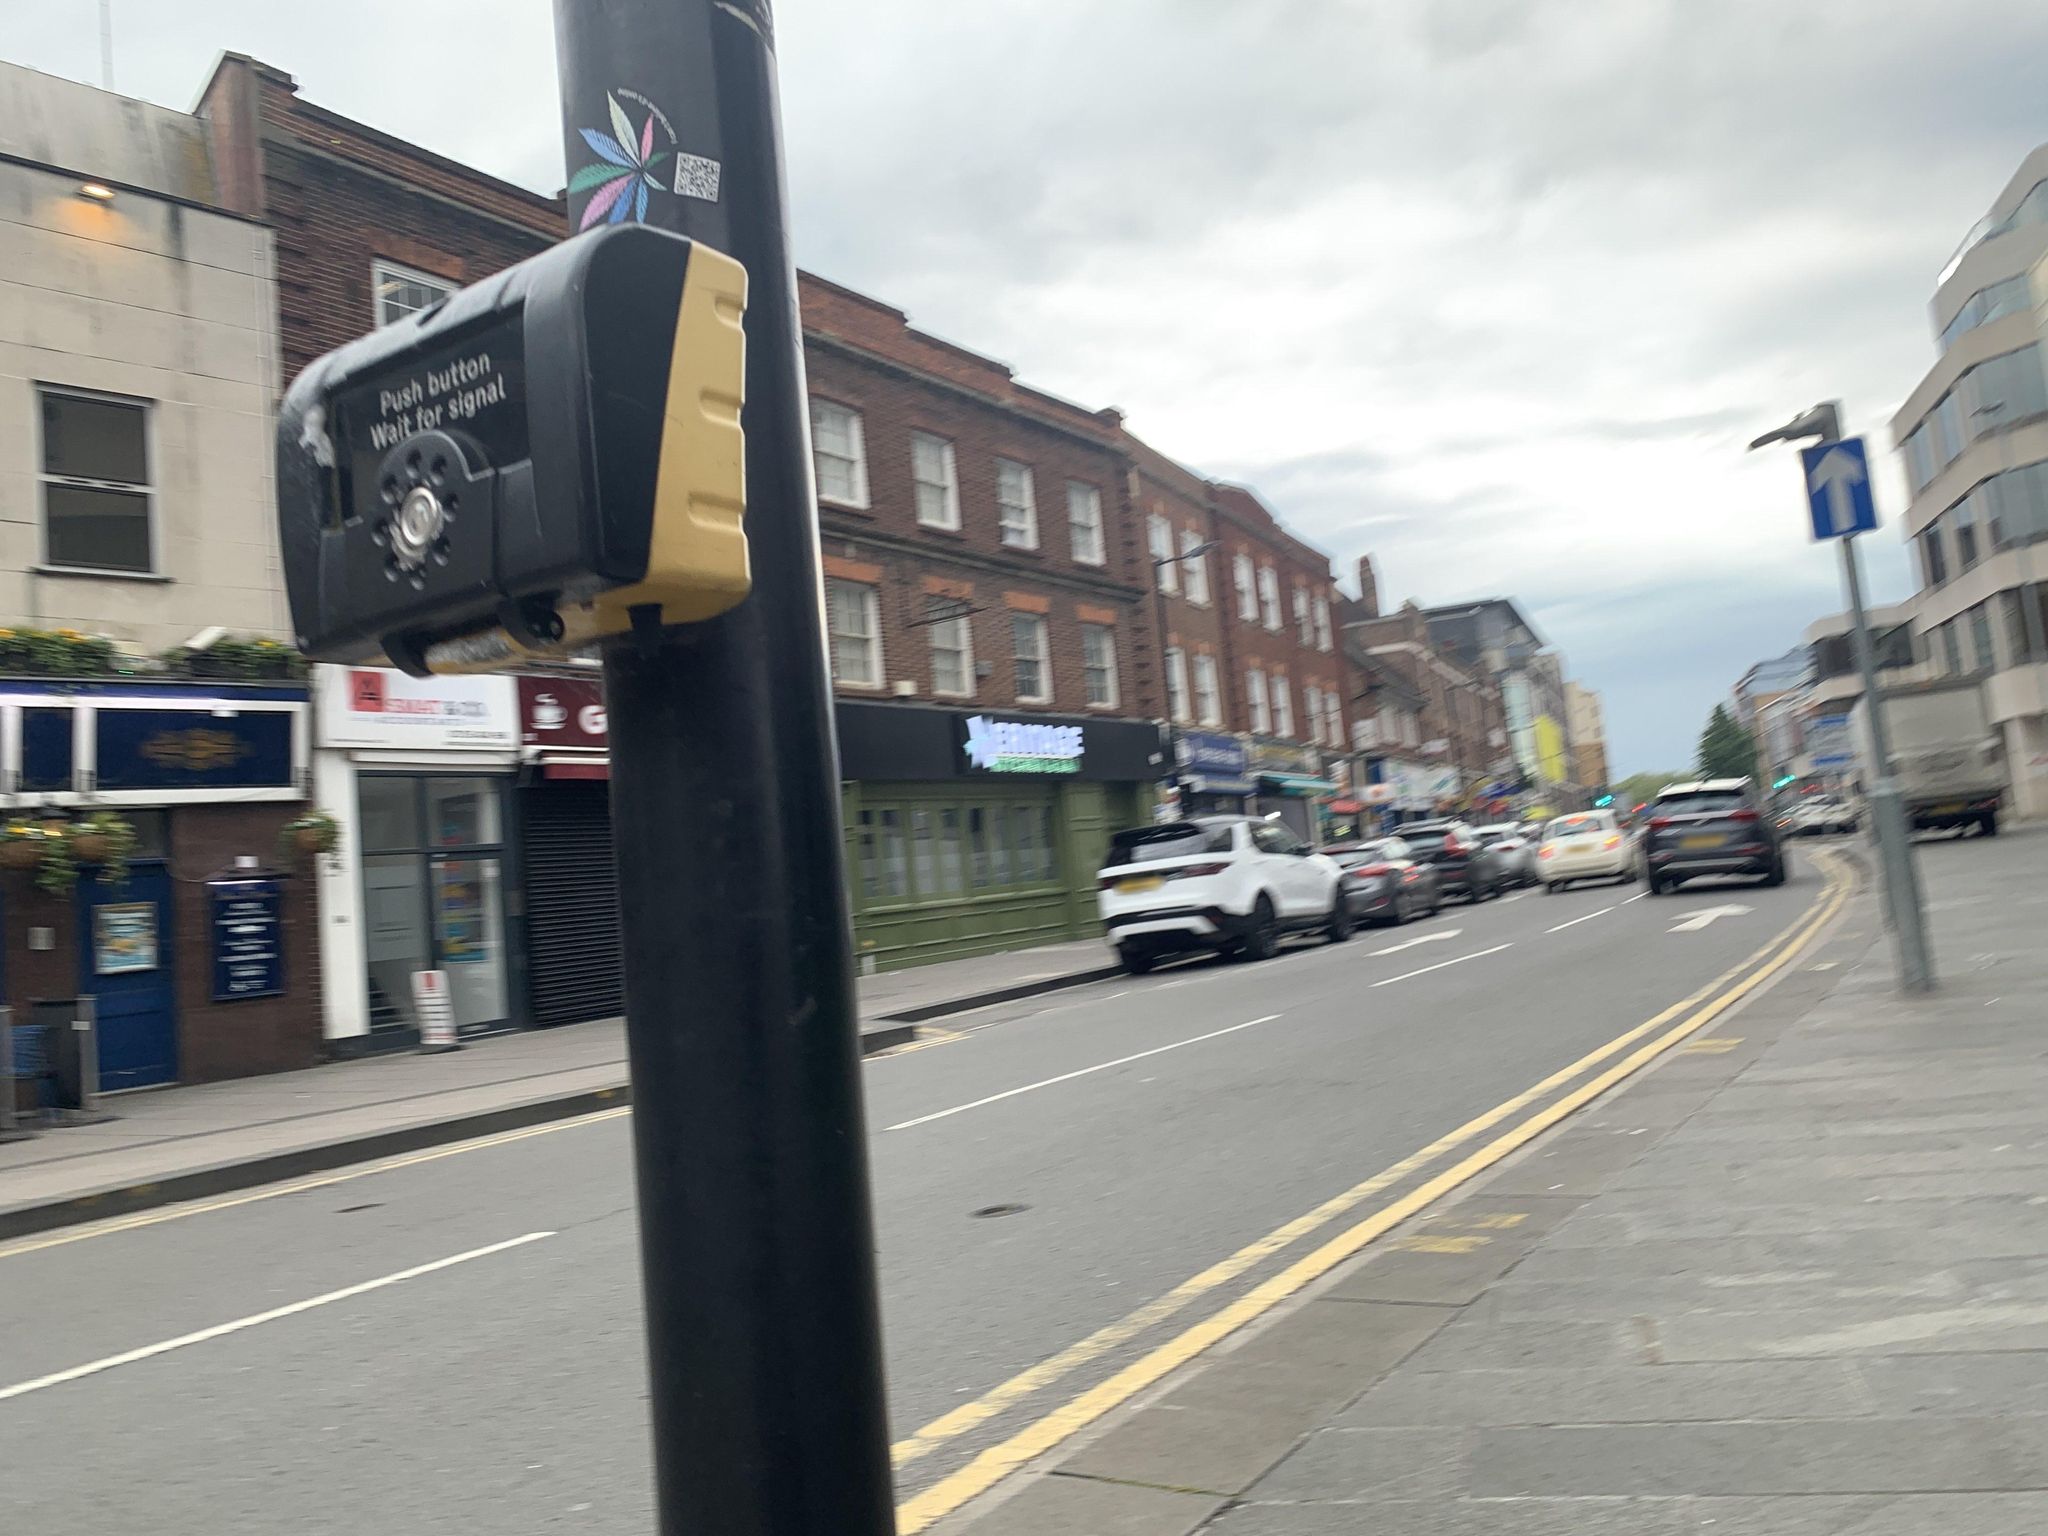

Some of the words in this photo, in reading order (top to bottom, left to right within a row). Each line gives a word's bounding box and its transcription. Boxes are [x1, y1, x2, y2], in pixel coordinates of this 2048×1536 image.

[369, 412, 411, 450] Wait
[416, 403, 443, 433] for
[448, 372, 506, 418] signal
[380, 378, 423, 417] Push
[427, 353, 491, 397] button
